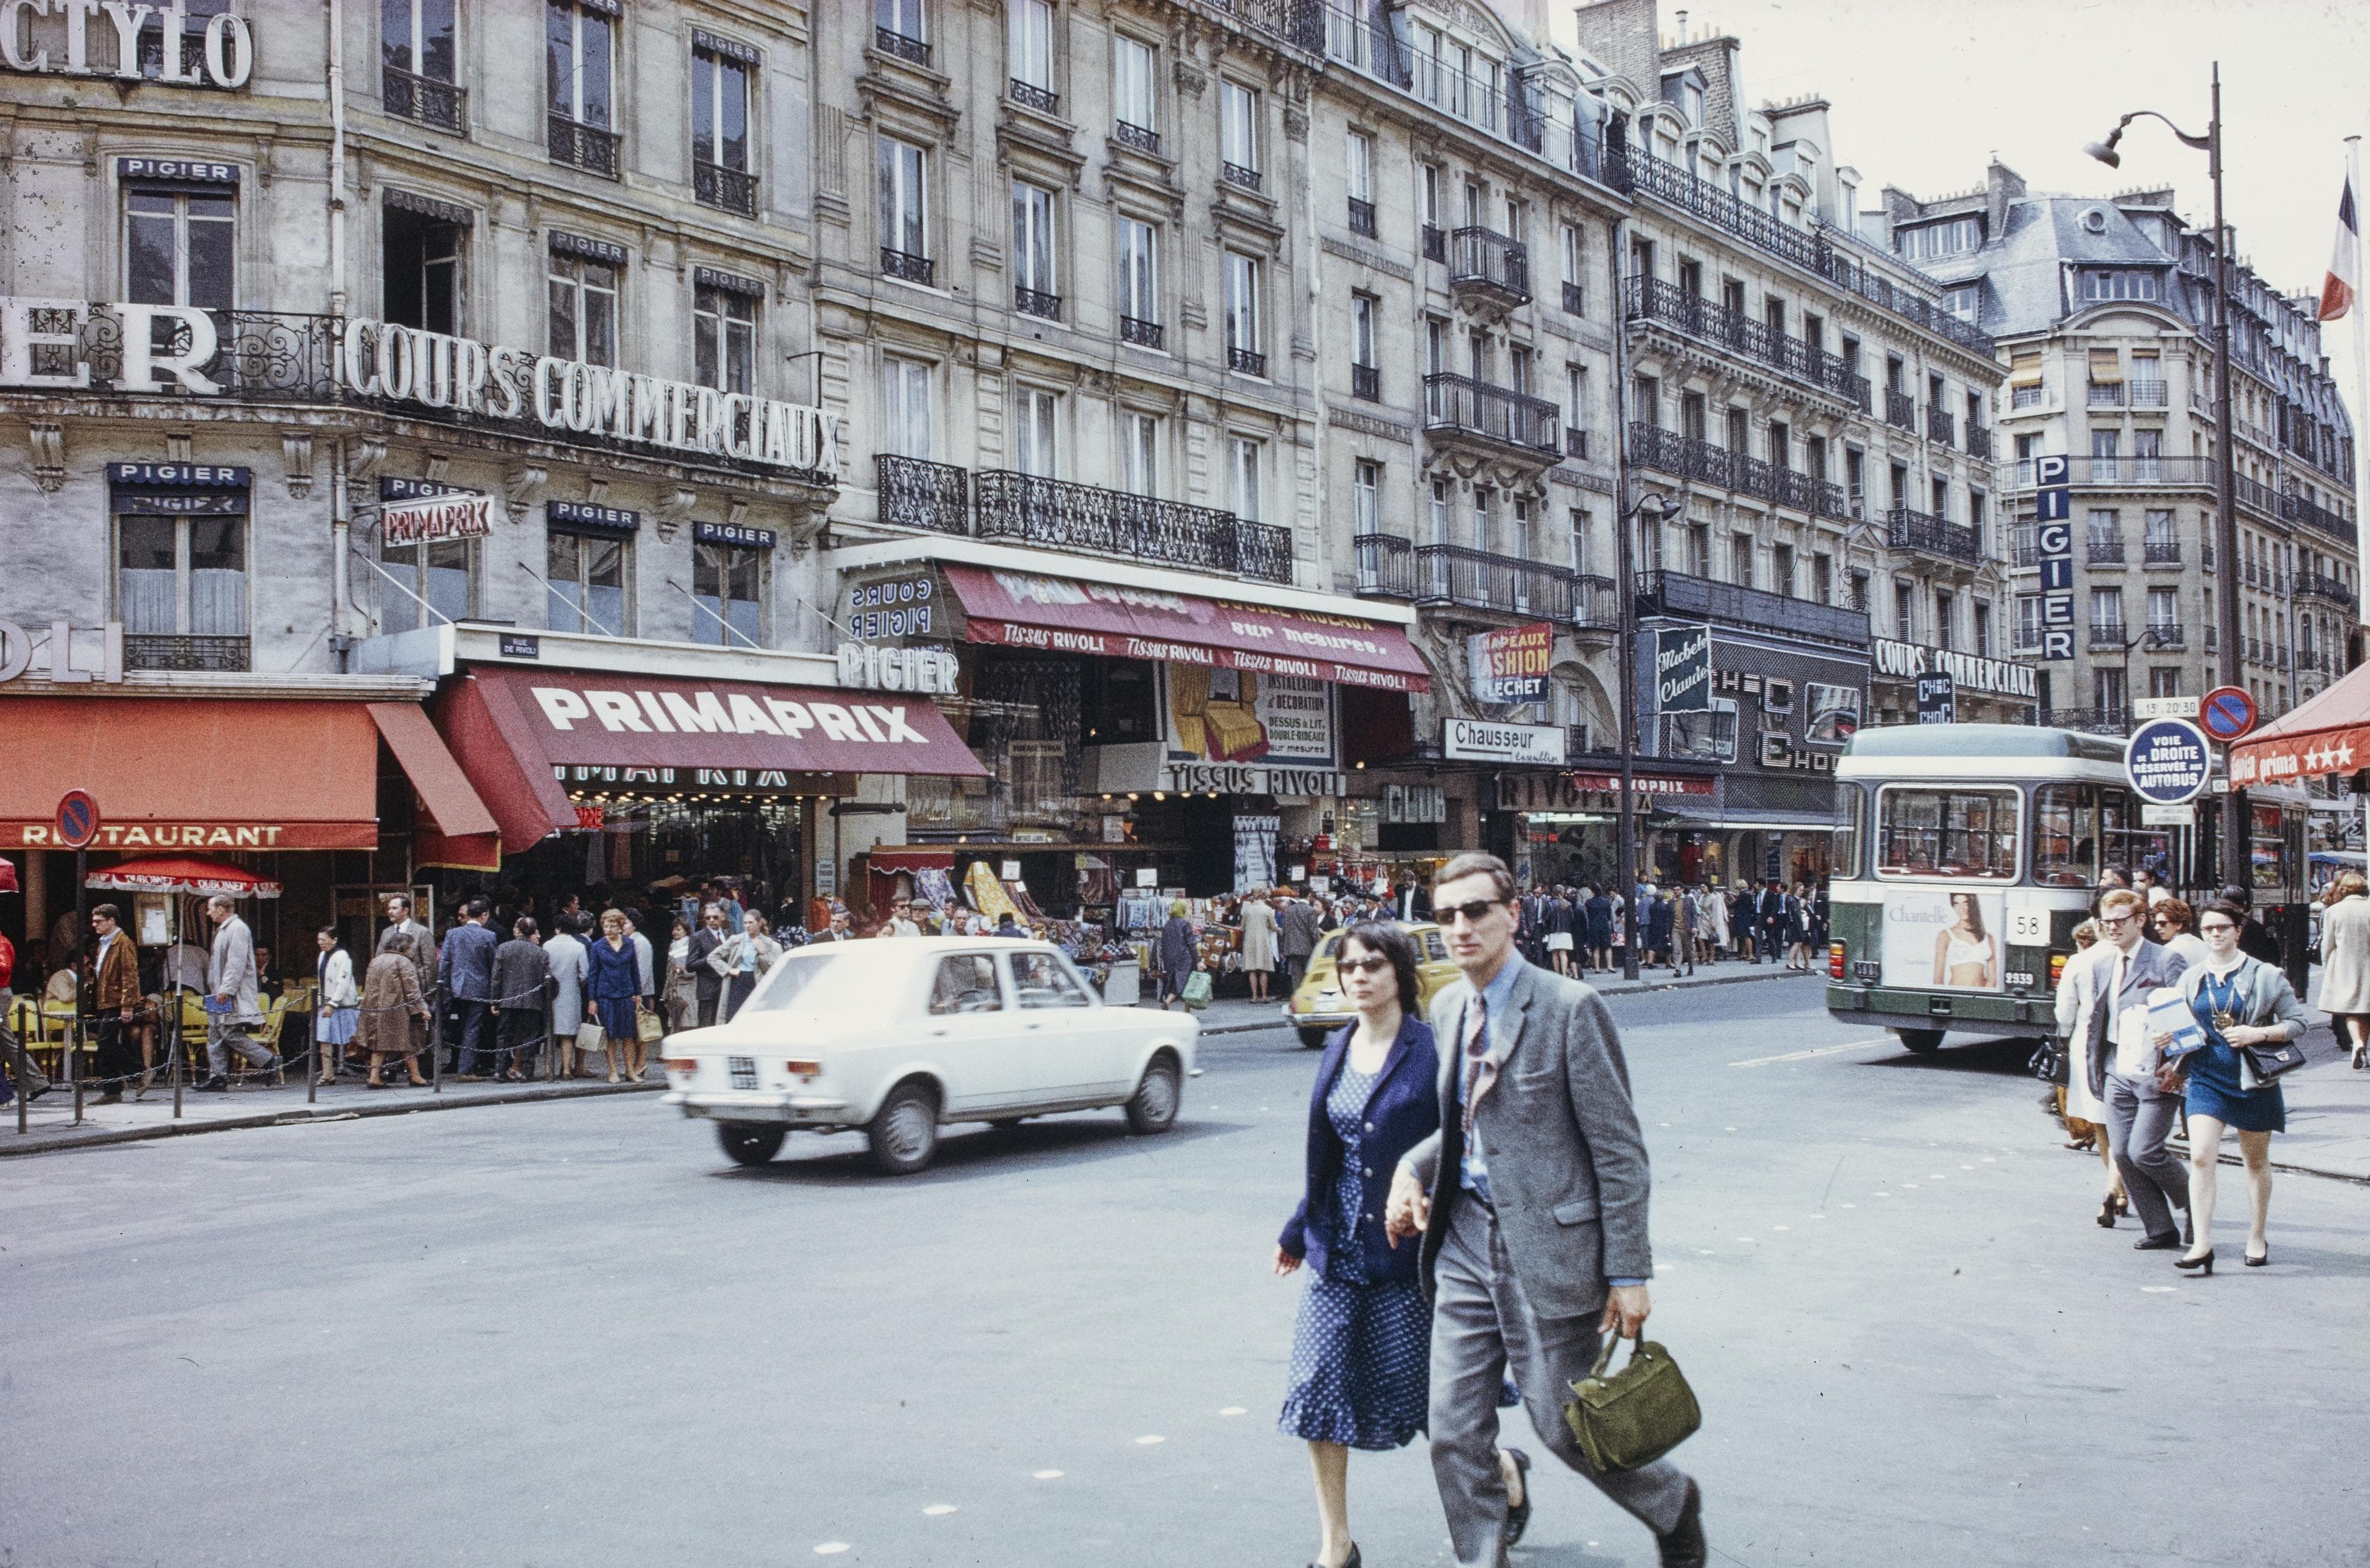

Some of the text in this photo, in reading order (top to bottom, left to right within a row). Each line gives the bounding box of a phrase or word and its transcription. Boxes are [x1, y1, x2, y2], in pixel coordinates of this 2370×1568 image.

[698, 31, 755, 60] PIGIER
[127, 159, 230, 179] PIGIER
[556, 233, 623, 259] PIGIER
[701, 268, 759, 291] PIGIER
[0, 297, 226, 396] ER
[345, 317, 841, 474] COURS COMMERCIAUX
[121, 464, 235, 481] PIGIER
[383, 501, 491, 545] PRIMAPRIX
[558, 503, 632, 523] PIGIER
[704, 524, 771, 543] PIGIER
[2039, 457, 2072, 658] PIGIER
[1230, 621, 1274, 638] sur
[513, 638, 527, 646] RUE
[515, 646, 537, 655] RIVOLI
[1053, 631, 1104, 652] RIVOLI
[1169, 644, 1213, 664] RIVOLI
[837, 642, 959, 694] PIGIER
[1274, 658, 1318, 676] RIVOLI
[1876, 639, 2037, 698] COURS COMMERCIAUX
[1369, 671, 1406, 689] RIVOLI
[1660, 666, 1708, 703] Claude
[531, 686, 930, 744] PRIMAPRIX
[1269, 717, 1301, 728] DESSUS
[1455, 721, 1533, 748] Chausseur
[2152, 735, 2182, 746] VOIE
[1287, 745, 1325, 753] mesures
[2150, 746, 2199, 762] DROITE
[2133, 760, 2187, 774] RÉSERVÉE
[2259, 749, 2298, 783] prima
[1168, 763, 1339, 796] TISSUS RIVOLI
[2140, 772, 2198, 788] AUTOBUS
[1388, 784, 1446, 823] CLUB
[22, 825, 284, 846] RTAURANT
[1890, 905, 1948, 924] Chantelle
[2017, 917, 2039, 935] 58
[2005, 972, 2034, 985] 2939
